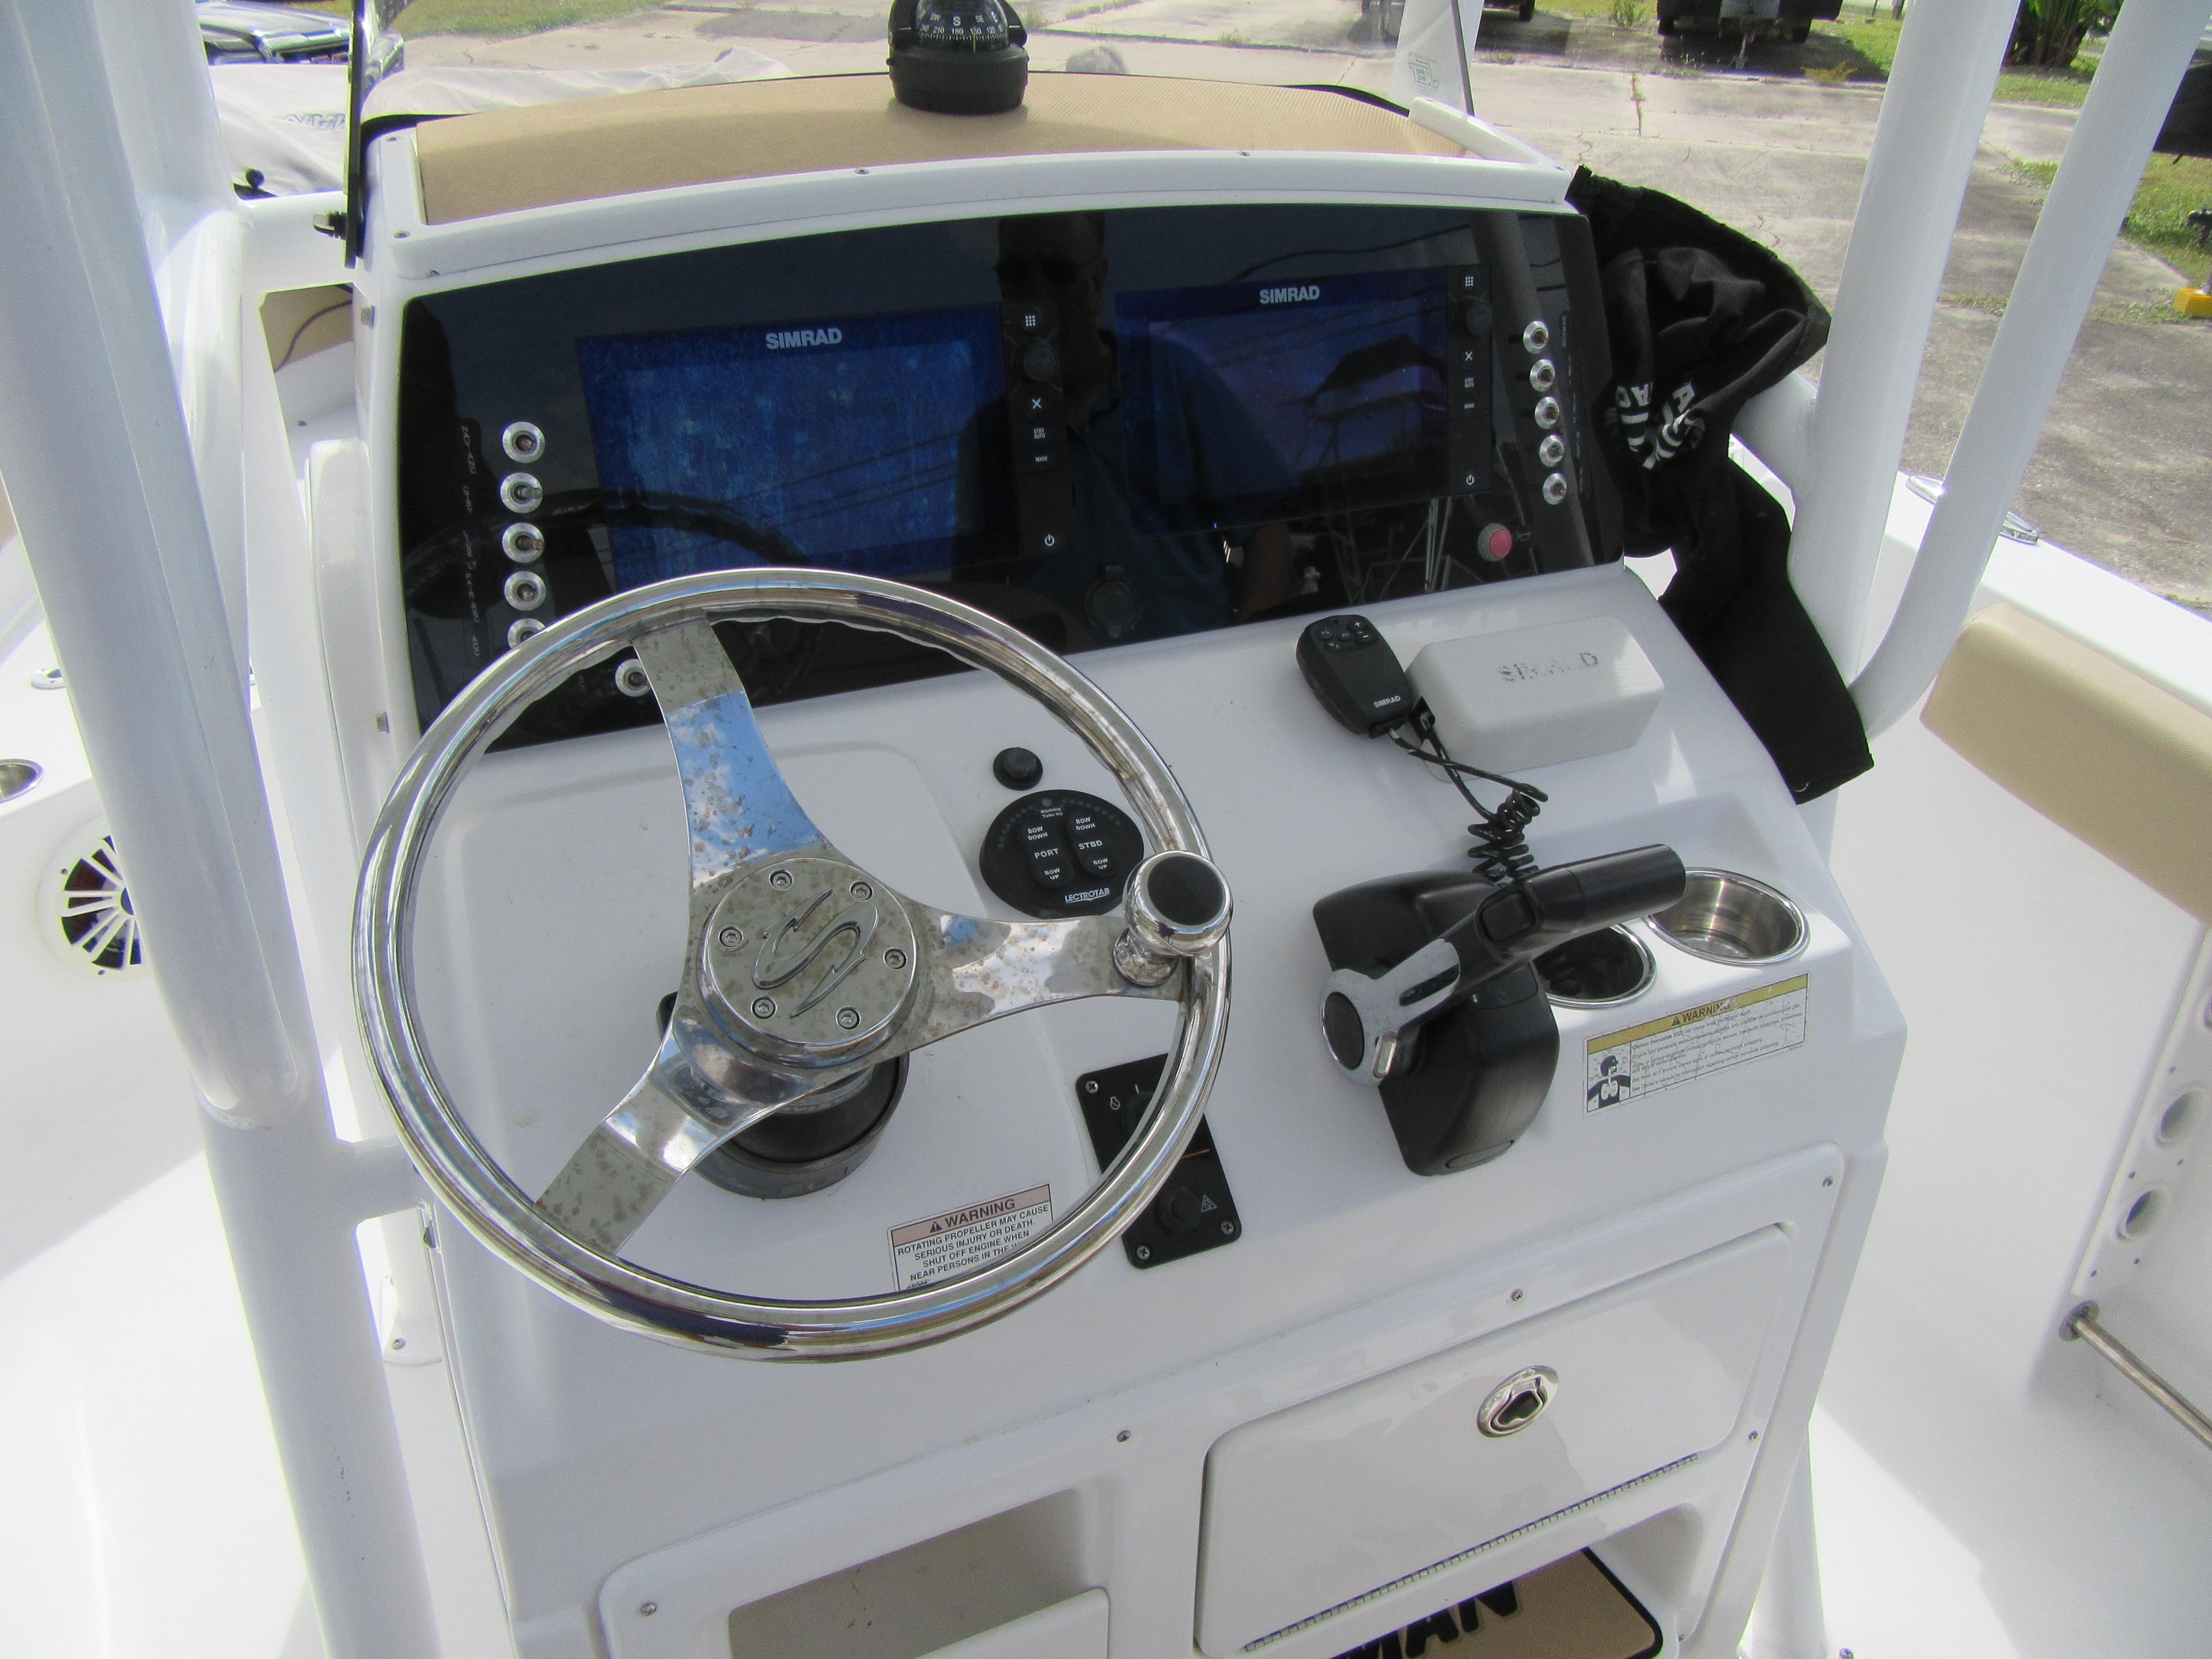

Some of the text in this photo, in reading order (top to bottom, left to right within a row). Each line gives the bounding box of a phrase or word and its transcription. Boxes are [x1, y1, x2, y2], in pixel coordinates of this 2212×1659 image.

[953, 16, 961, 26] S
[976, 15, 985, 23] SE
[933, 26, 945, 35] 210
[952, 28, 964, 36] 180
[1259, 285, 1320, 305] SIMRAD
[765, 327, 843, 350] SIMRAD
[1373, 695, 1402, 709] SIMRAD
[1075, 816, 1091, 825] BOW
[1075, 822, 1096, 831] DOWN
[1027, 825, 1043, 834] BOW
[1028, 831, 1048, 841] DOWN
[1078, 839, 1103, 850] STBD
[1034, 847, 1059, 859] PORT
[1093, 858, 1108, 866] BOW
[1044, 867, 1060, 876] BOW
[1065, 887, 1111, 903] LECTROTAB
[945, 1198, 1016, 1228] WARNING
[897, 1204, 1049, 1256] ROTATING PROPELLER MAY CAUSE
[914, 1219, 1036, 1261] SERIOUS INJURY OR DEATH.
[923, 1255, 946, 1268] SHUT
[949, 1249, 967, 1260] OFF
[968, 1238, 1002, 1255] ENGINE
[1003, 1229, 1029, 1244] WHEN
[910, 1268, 935, 1282] NEAR
[937, 1256, 980, 1274] PERSONS
[982, 1250, 991, 1260] IN
[993, 1245, 1010, 1256] THE
